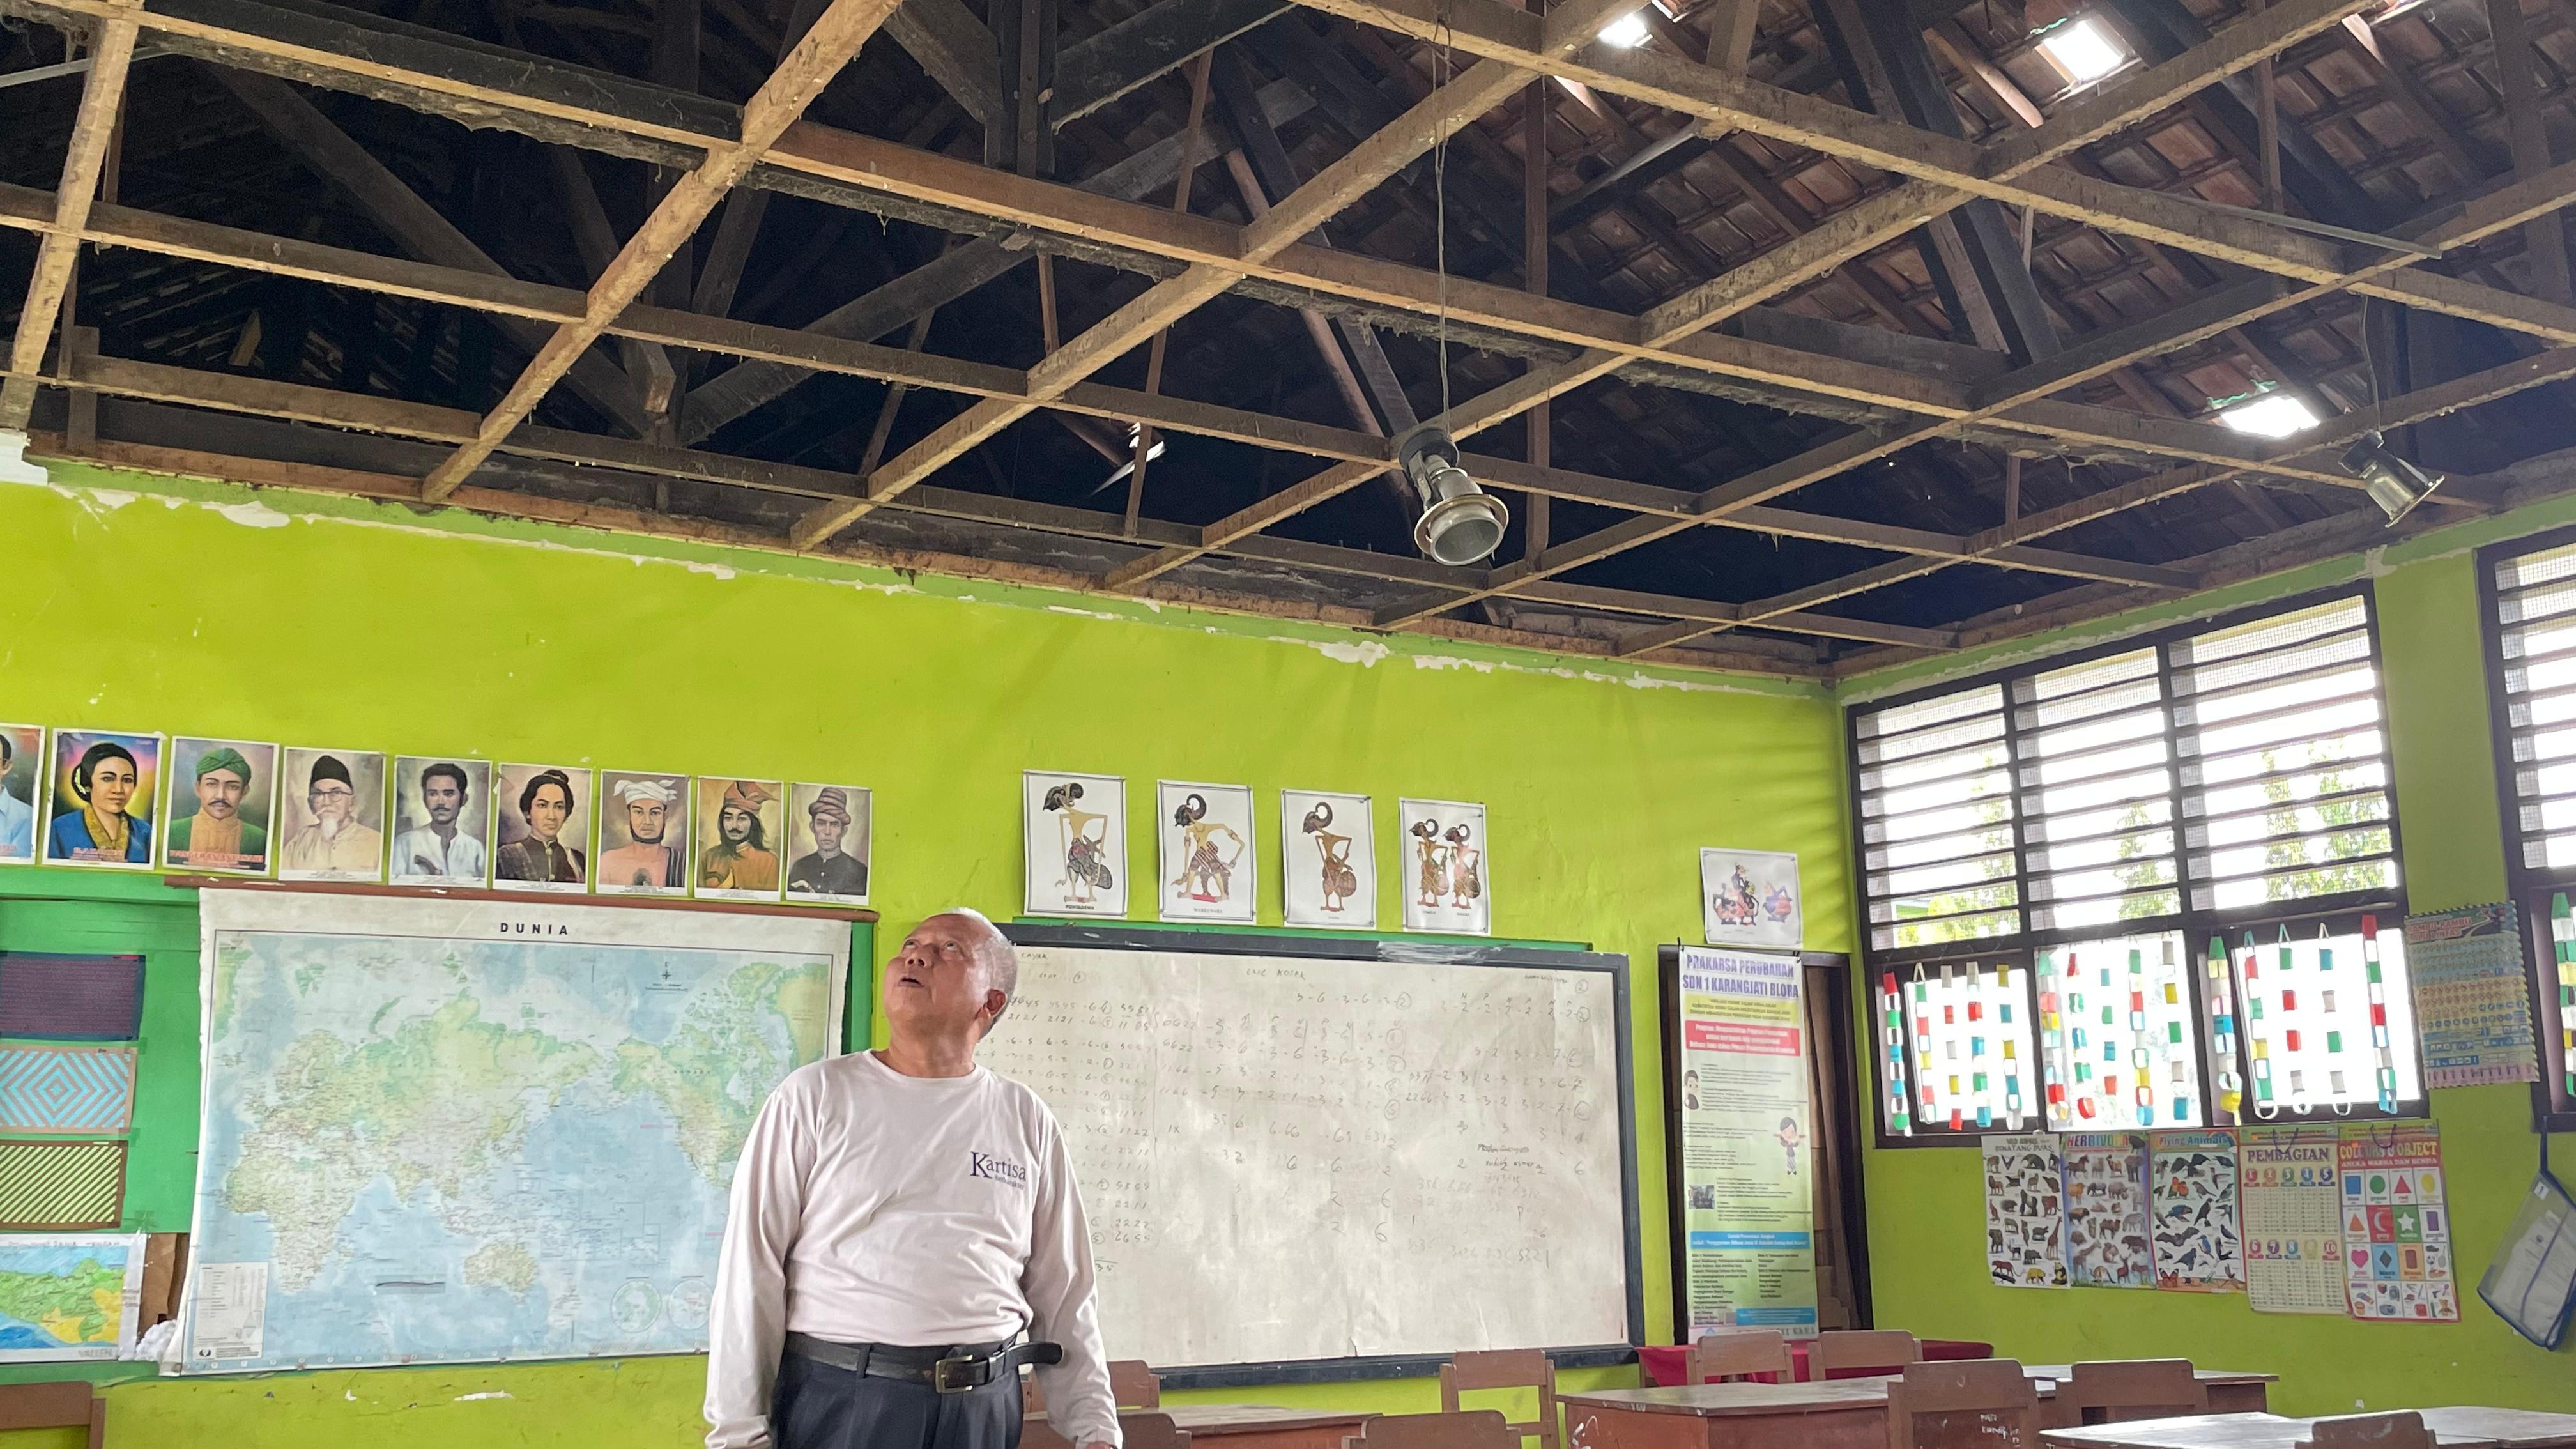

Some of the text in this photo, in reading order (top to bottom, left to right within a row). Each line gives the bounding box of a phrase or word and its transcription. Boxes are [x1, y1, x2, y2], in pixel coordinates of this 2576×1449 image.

[500, 923, 568, 935] DUNIA
[1687, 954, 1794, 977] PRAKARSA PERUBAHAN
[1683, 975, 1799, 998] SDN 1 KARANGJATI BLORA
[2248, 1148, 2329, 1163] PEMBAGIAN
[2396, 1141, 2437, 1156] OBJECT
[970, 1151, 1027, 1181] Kartisa
[1374, 1222, 1387, 1242] 6
